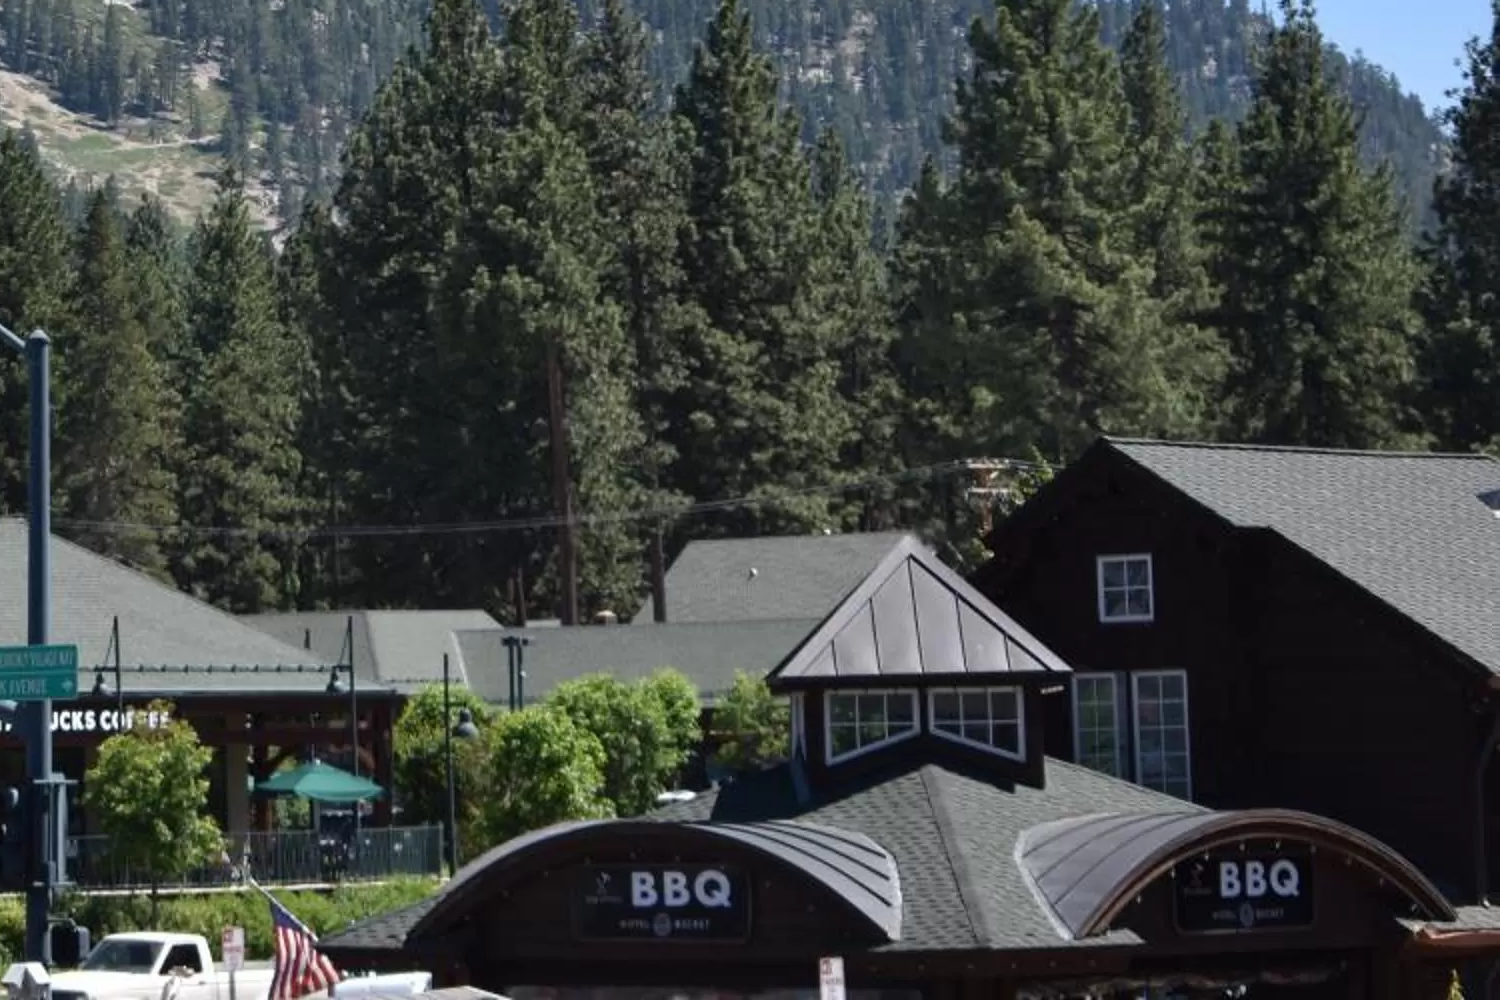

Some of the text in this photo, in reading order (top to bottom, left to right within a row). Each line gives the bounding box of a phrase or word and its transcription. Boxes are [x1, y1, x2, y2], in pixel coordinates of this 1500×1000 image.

[9, 678, 48, 696] AVENUE
[631, 869, 732, 908] BBQ
[1219, 859, 1300, 899] BBQ
